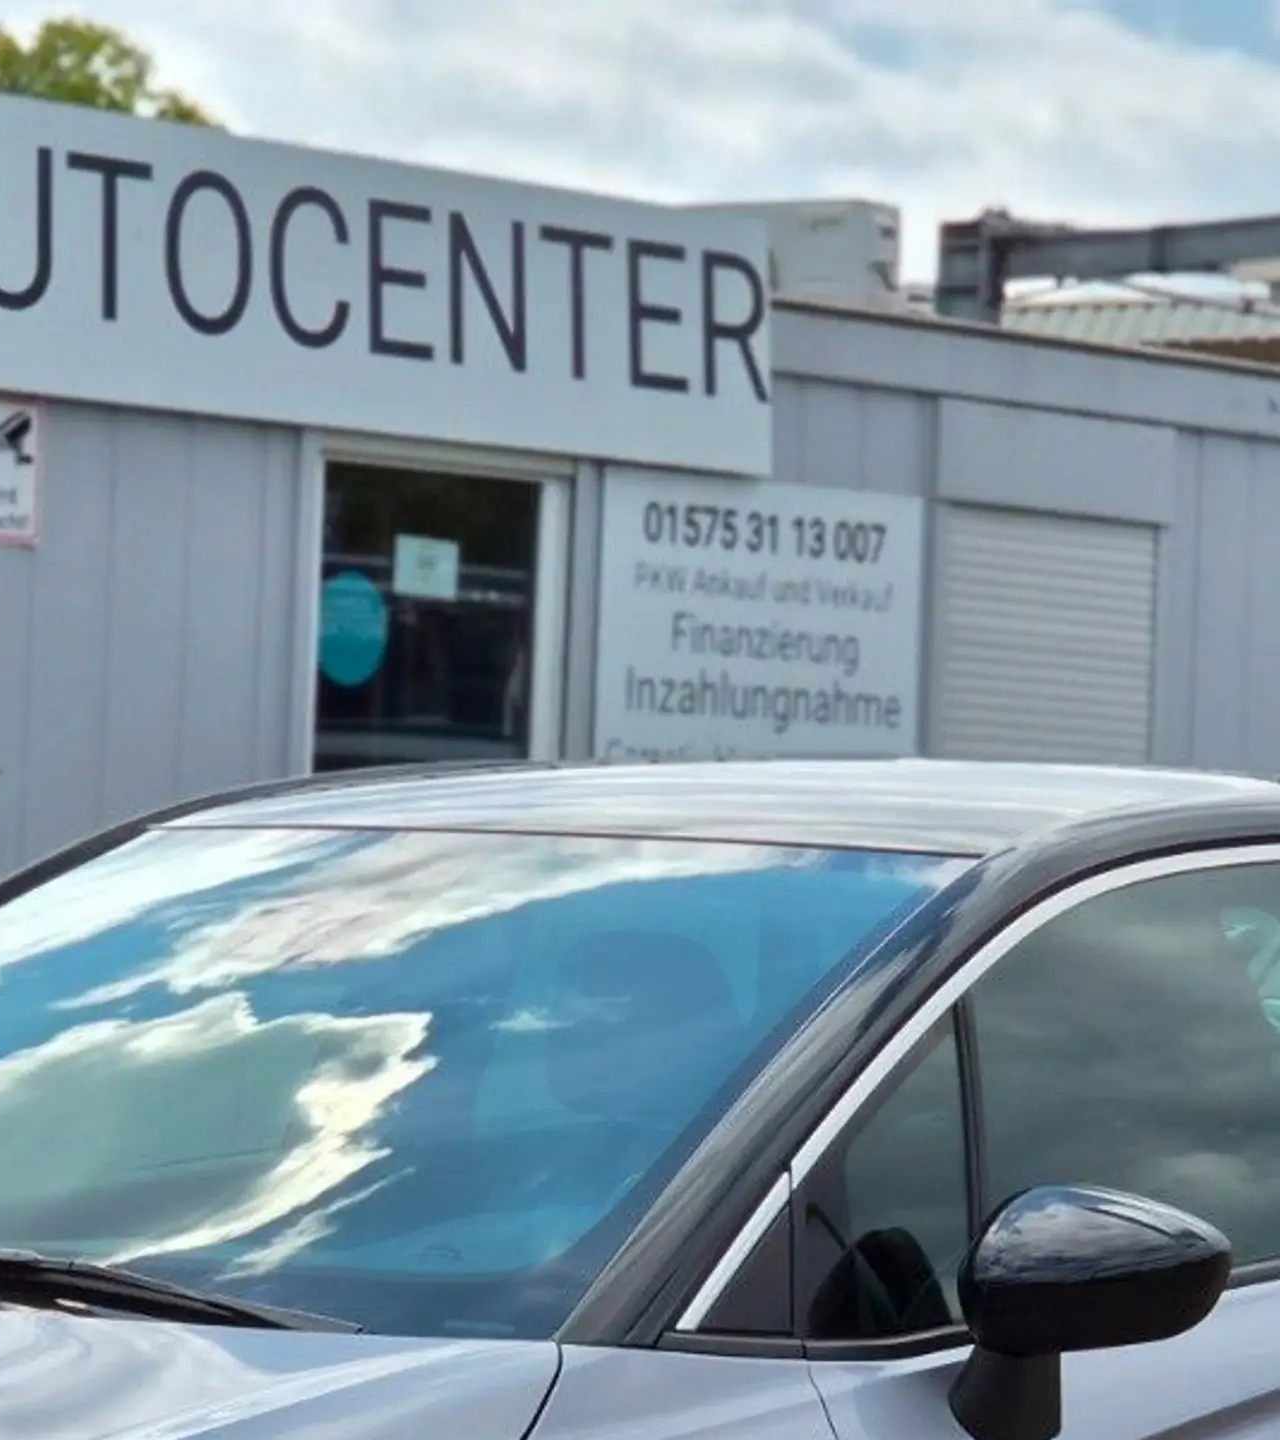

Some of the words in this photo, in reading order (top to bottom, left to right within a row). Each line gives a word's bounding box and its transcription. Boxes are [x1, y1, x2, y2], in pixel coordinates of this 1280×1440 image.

[642, 500, 740, 551] 01575
[745, 510, 780, 555] 31
[791, 516, 828, 559] 13
[833, 520, 888, 565] 007
[670, 610, 861, 678] Finanzierung
[624, 664, 902, 735] Inzahlungnahme
